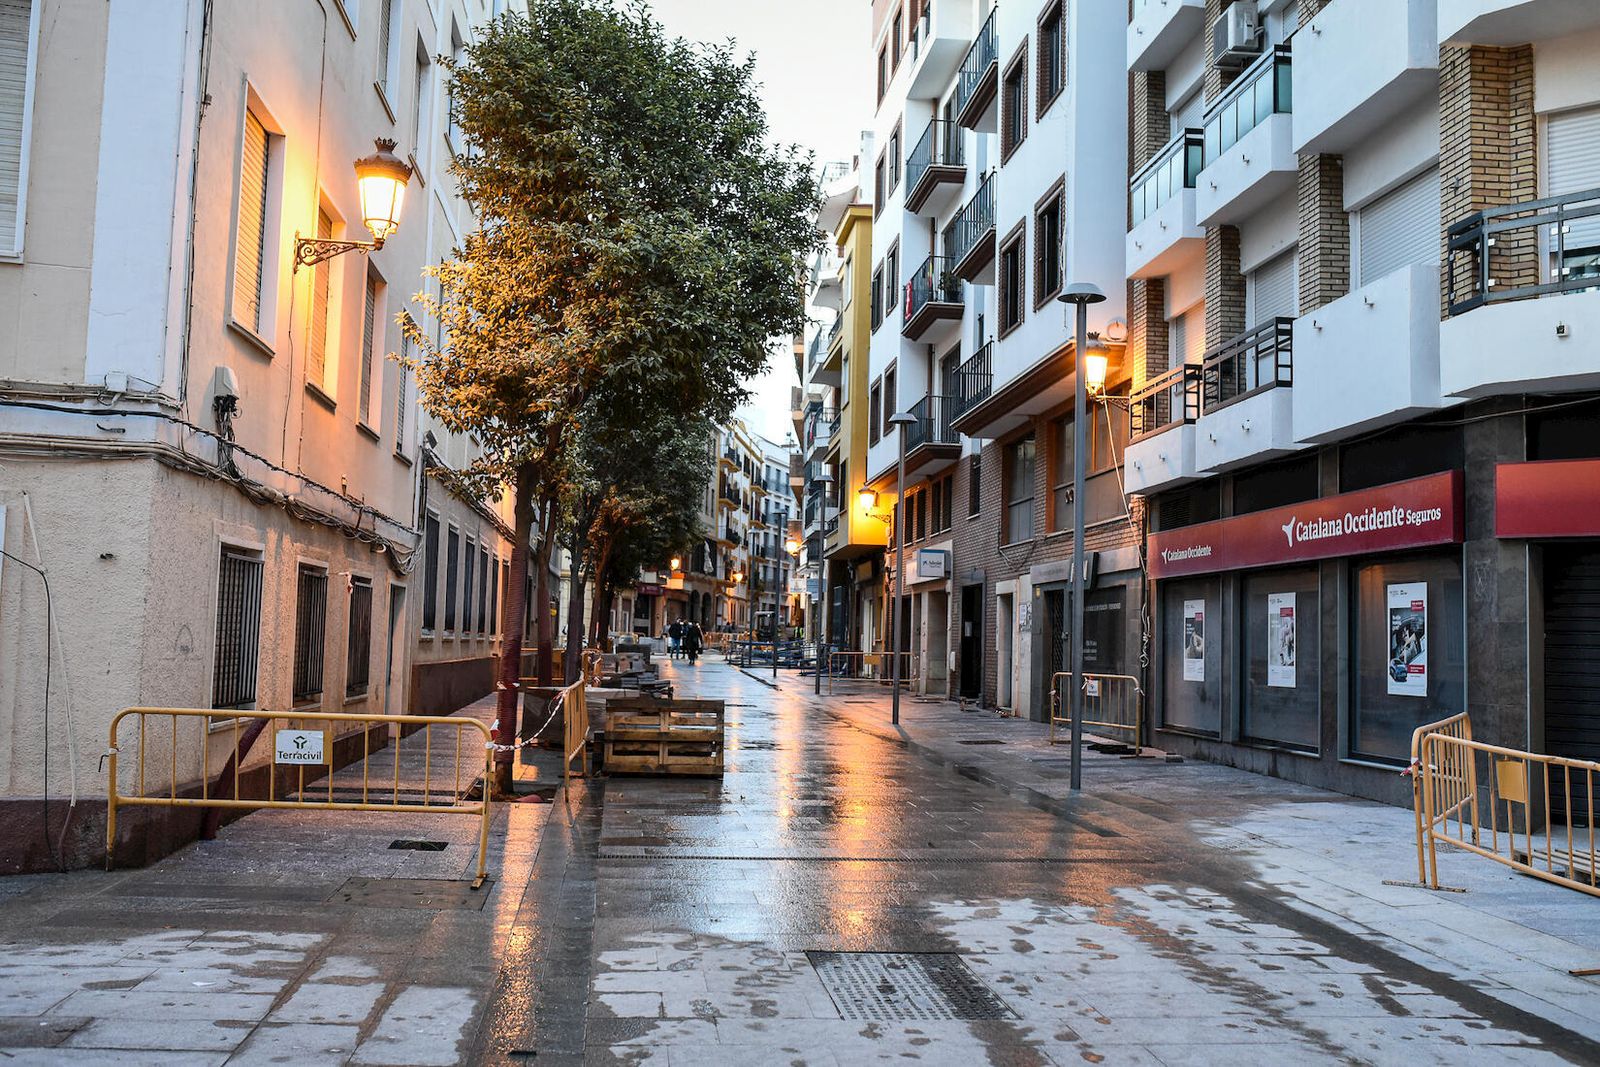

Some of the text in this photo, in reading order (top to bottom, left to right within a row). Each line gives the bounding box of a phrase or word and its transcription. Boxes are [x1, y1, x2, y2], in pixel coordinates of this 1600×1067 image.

[1296, 505, 1441, 541] Catalana Occidente Seguros
[278, 751, 321, 760] Terracivil
